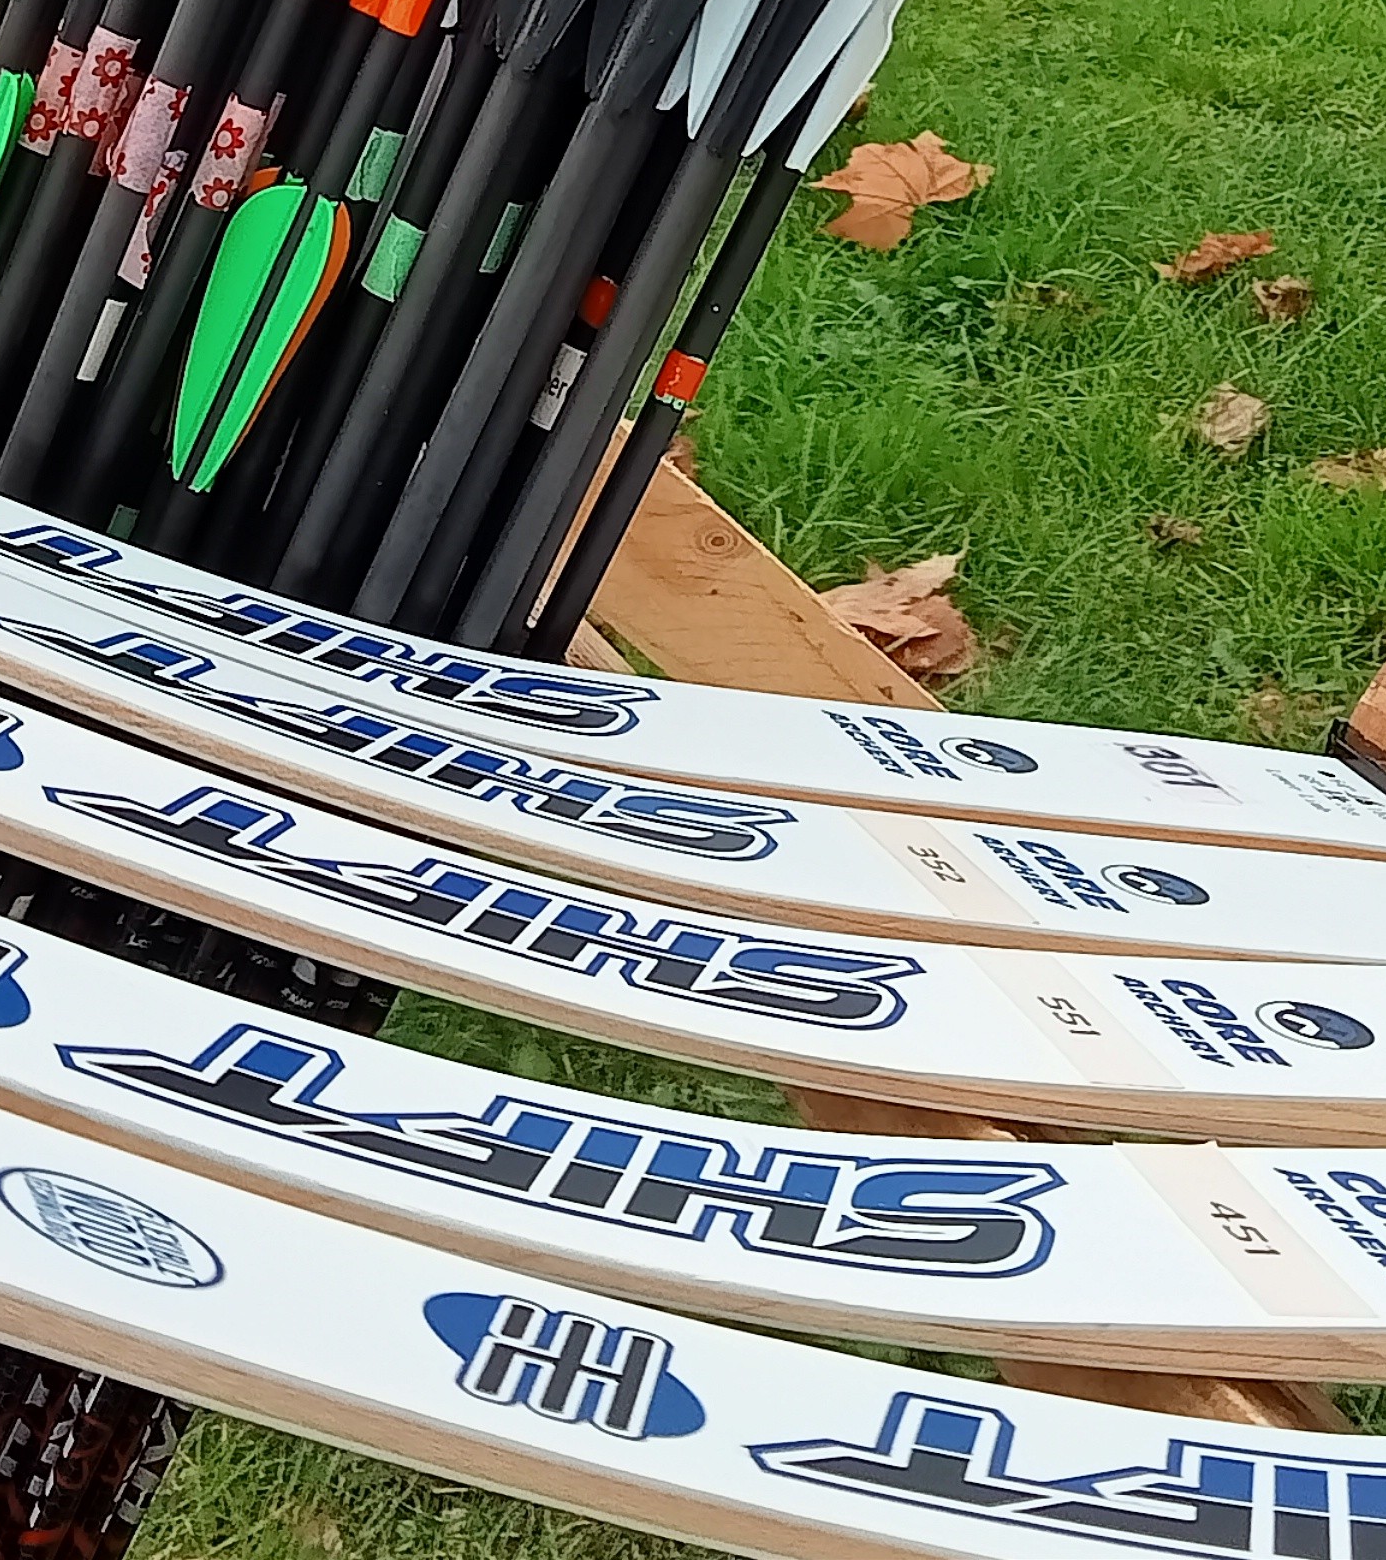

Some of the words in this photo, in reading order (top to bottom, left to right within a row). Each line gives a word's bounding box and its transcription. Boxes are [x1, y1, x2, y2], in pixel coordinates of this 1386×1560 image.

[862, 716, 962, 782] CORE
[907, 845, 966, 883] 352
[973, 833, 1077, 910] ARCHERY
[1017, 840, 1130, 913] CORE
[42, 785, 926, 1030] SHIFT
[1037, 996, 1101, 1036] 551
[1113, 974, 1235, 1067] ARCHERY
[1161, 979, 1292, 1067] CORE
[54, 1023, 1068, 1278] SHIFT
[1210, 1201, 1281, 1255] 451
